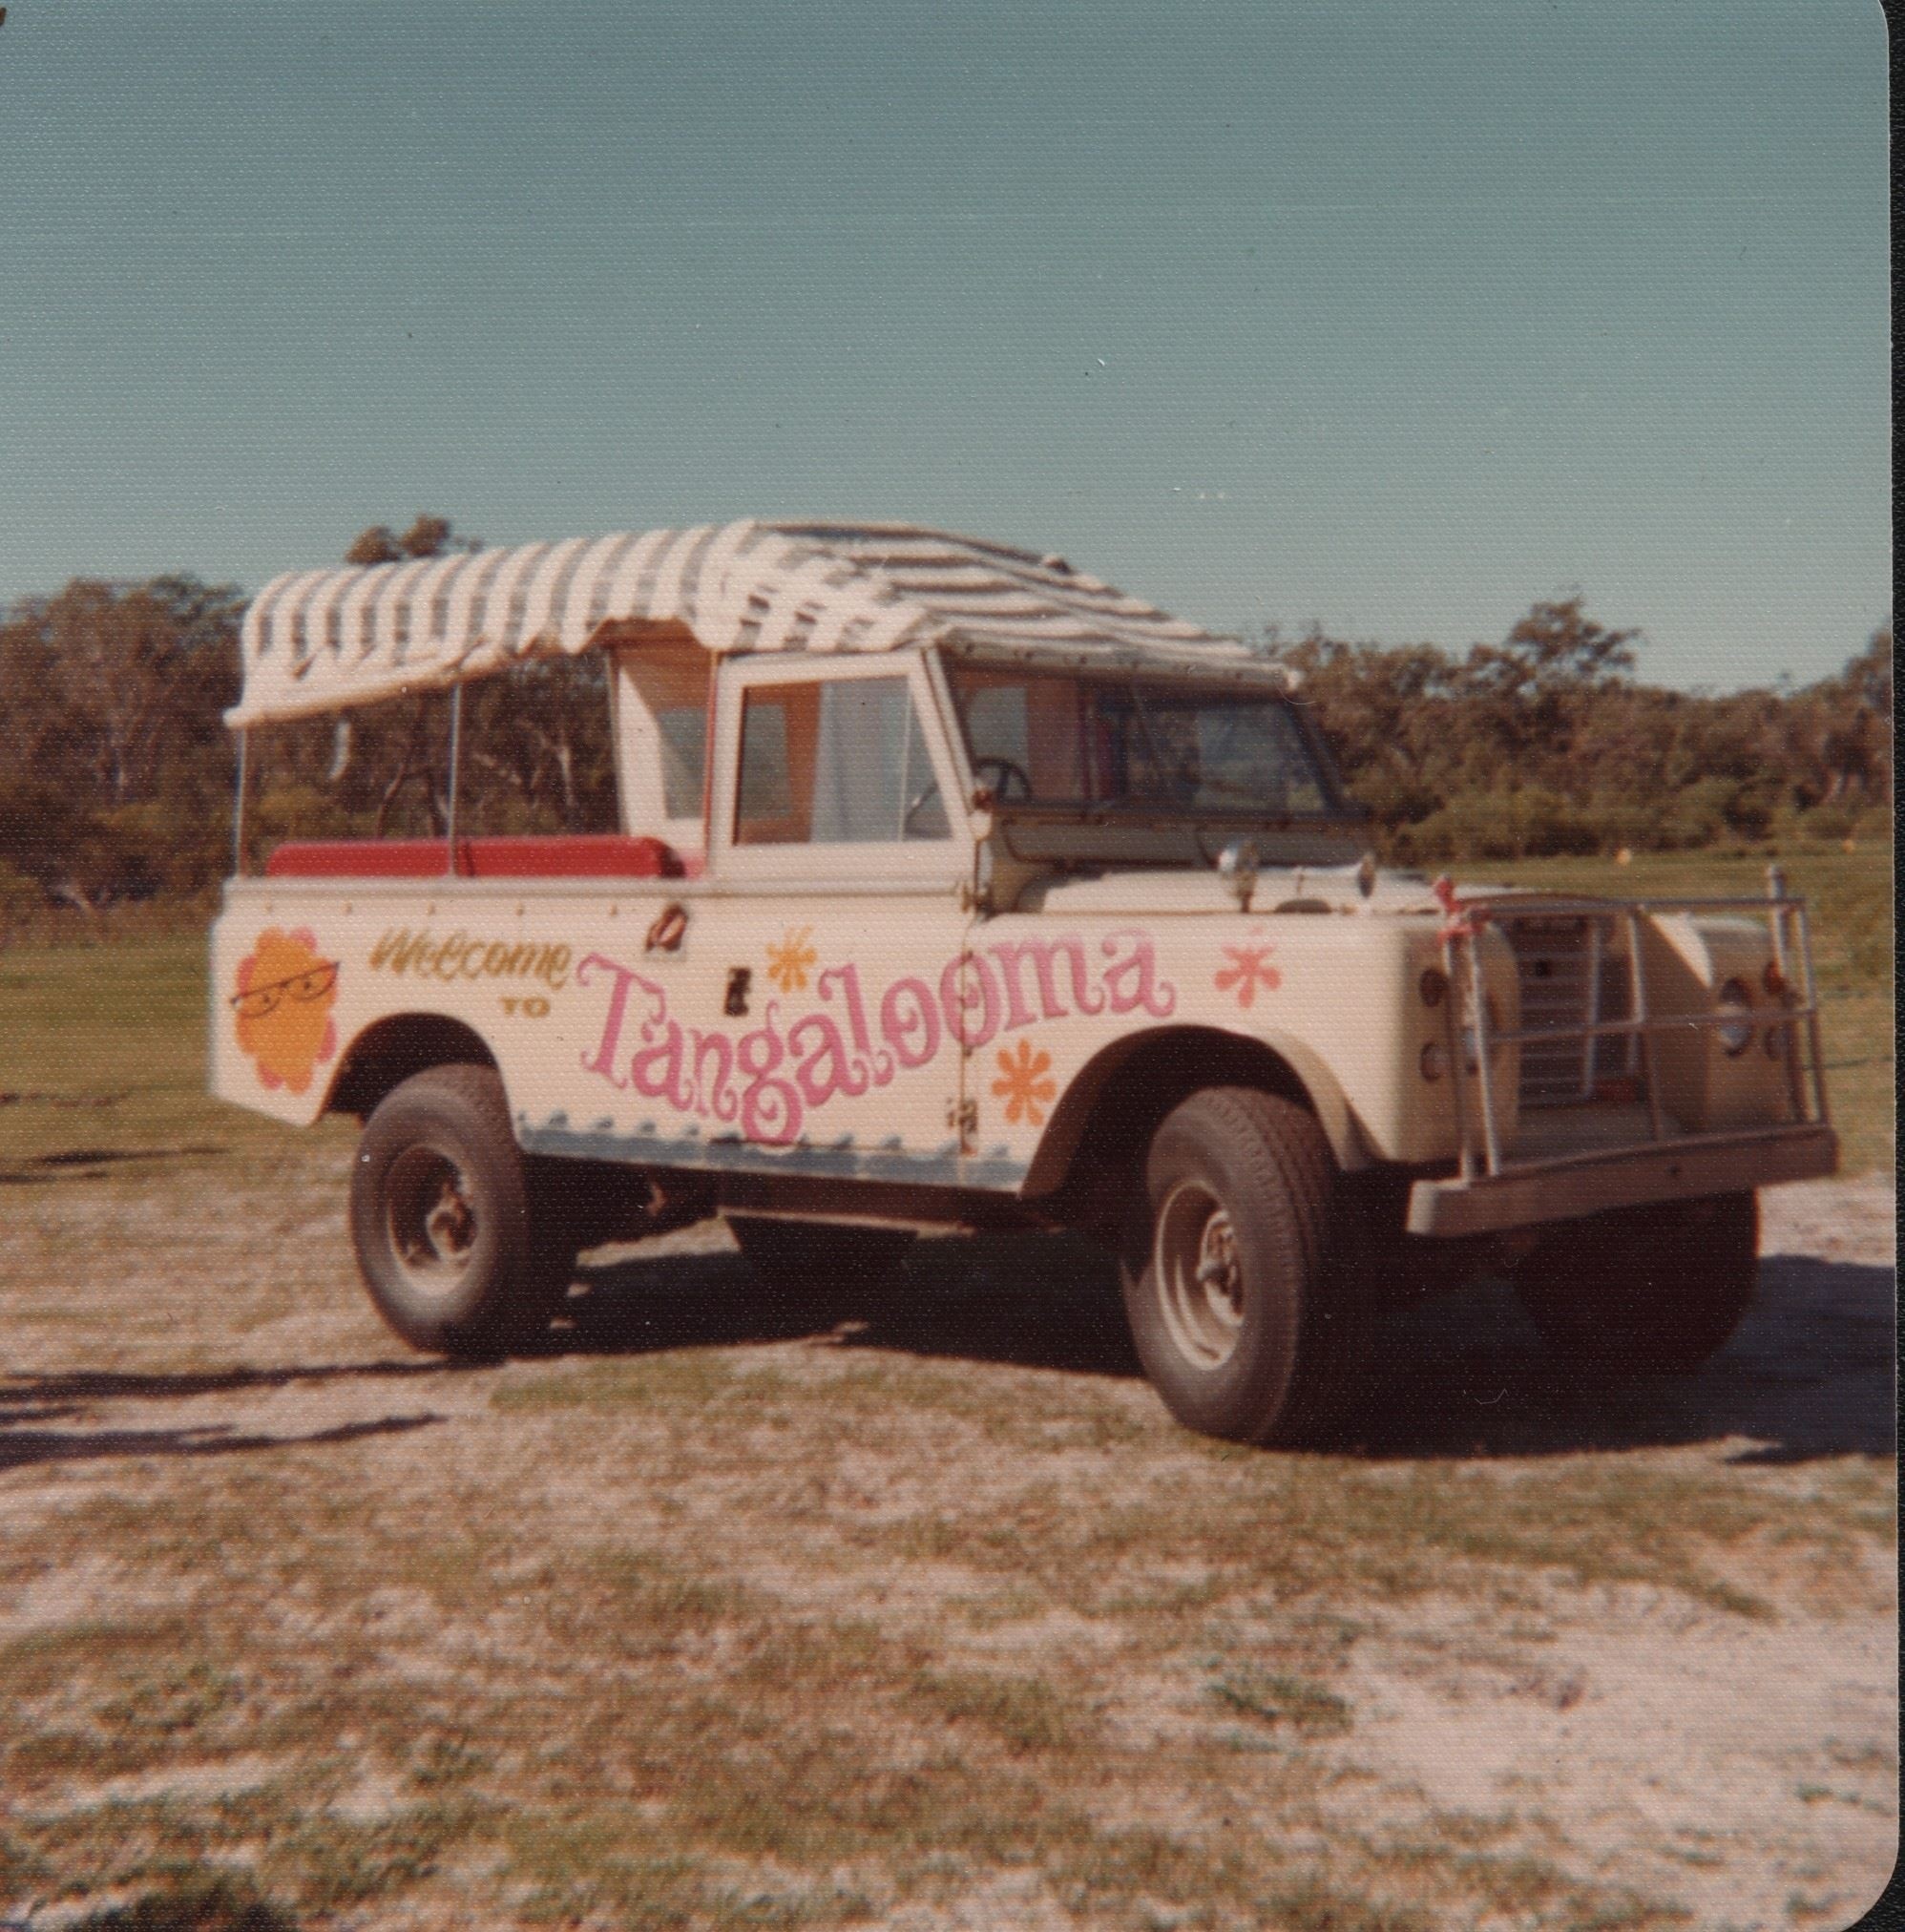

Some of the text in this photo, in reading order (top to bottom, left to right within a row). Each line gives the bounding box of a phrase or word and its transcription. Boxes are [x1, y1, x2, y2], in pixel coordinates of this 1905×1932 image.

[368, 927, 574, 990] Welcome
[499, 997, 552, 1019] TO
[576, 927, 1178, 1147] Tangalooma
